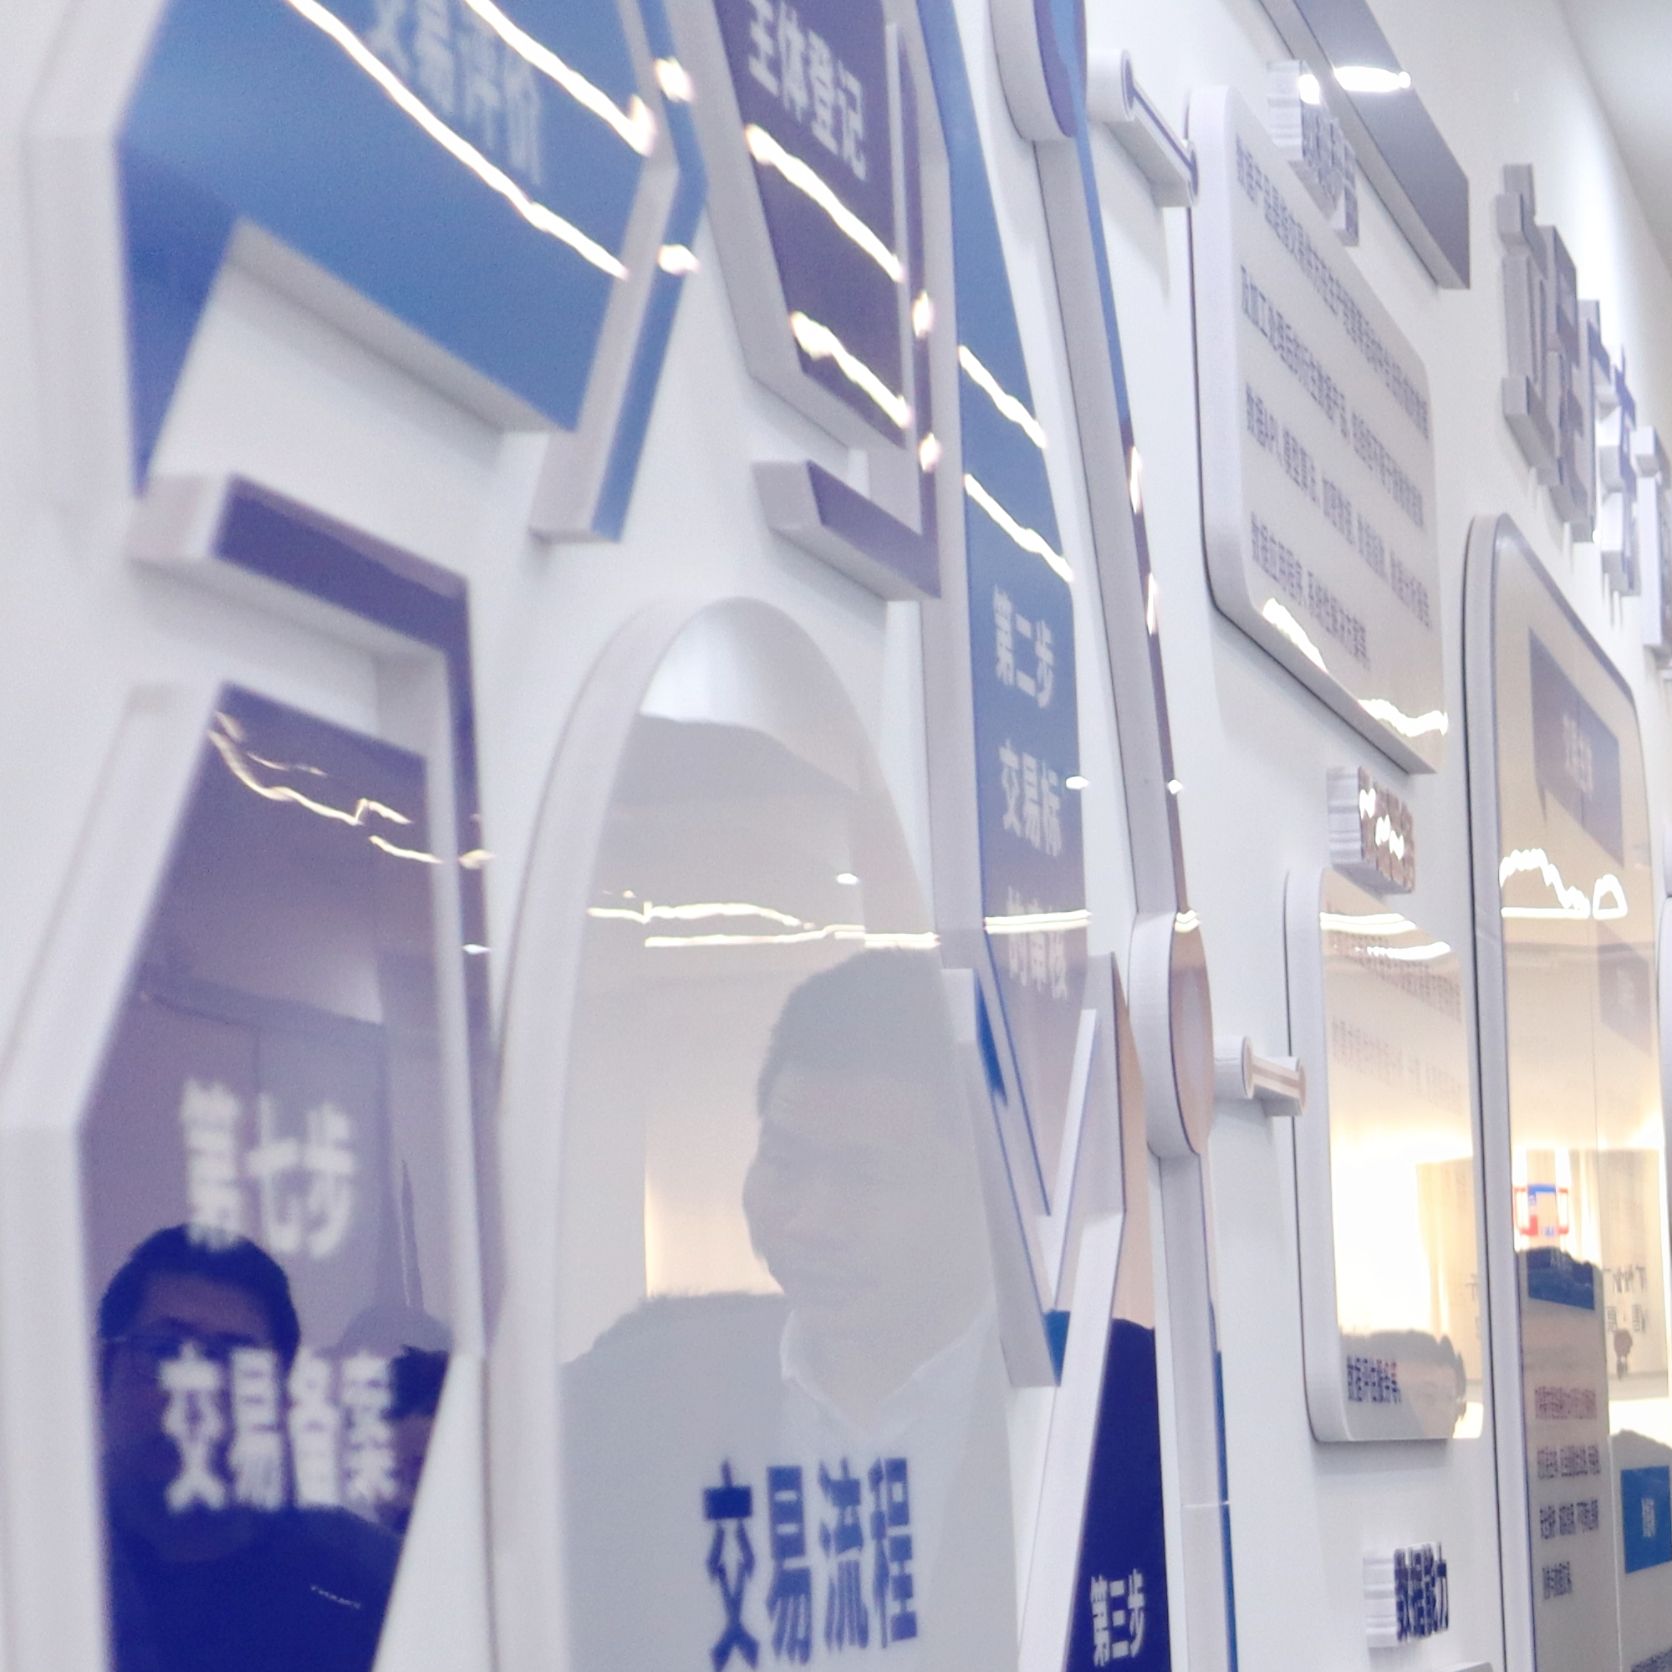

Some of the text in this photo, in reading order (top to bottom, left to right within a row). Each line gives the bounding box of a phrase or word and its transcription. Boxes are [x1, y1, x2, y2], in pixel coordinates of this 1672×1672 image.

[992, 583, 1055, 708] 第二步
[181, 1077, 355, 1257] 第七步
[1090, 1568, 1145, 1667] 第三步
[1394, 1542, 1448, 1642] 数据能力
